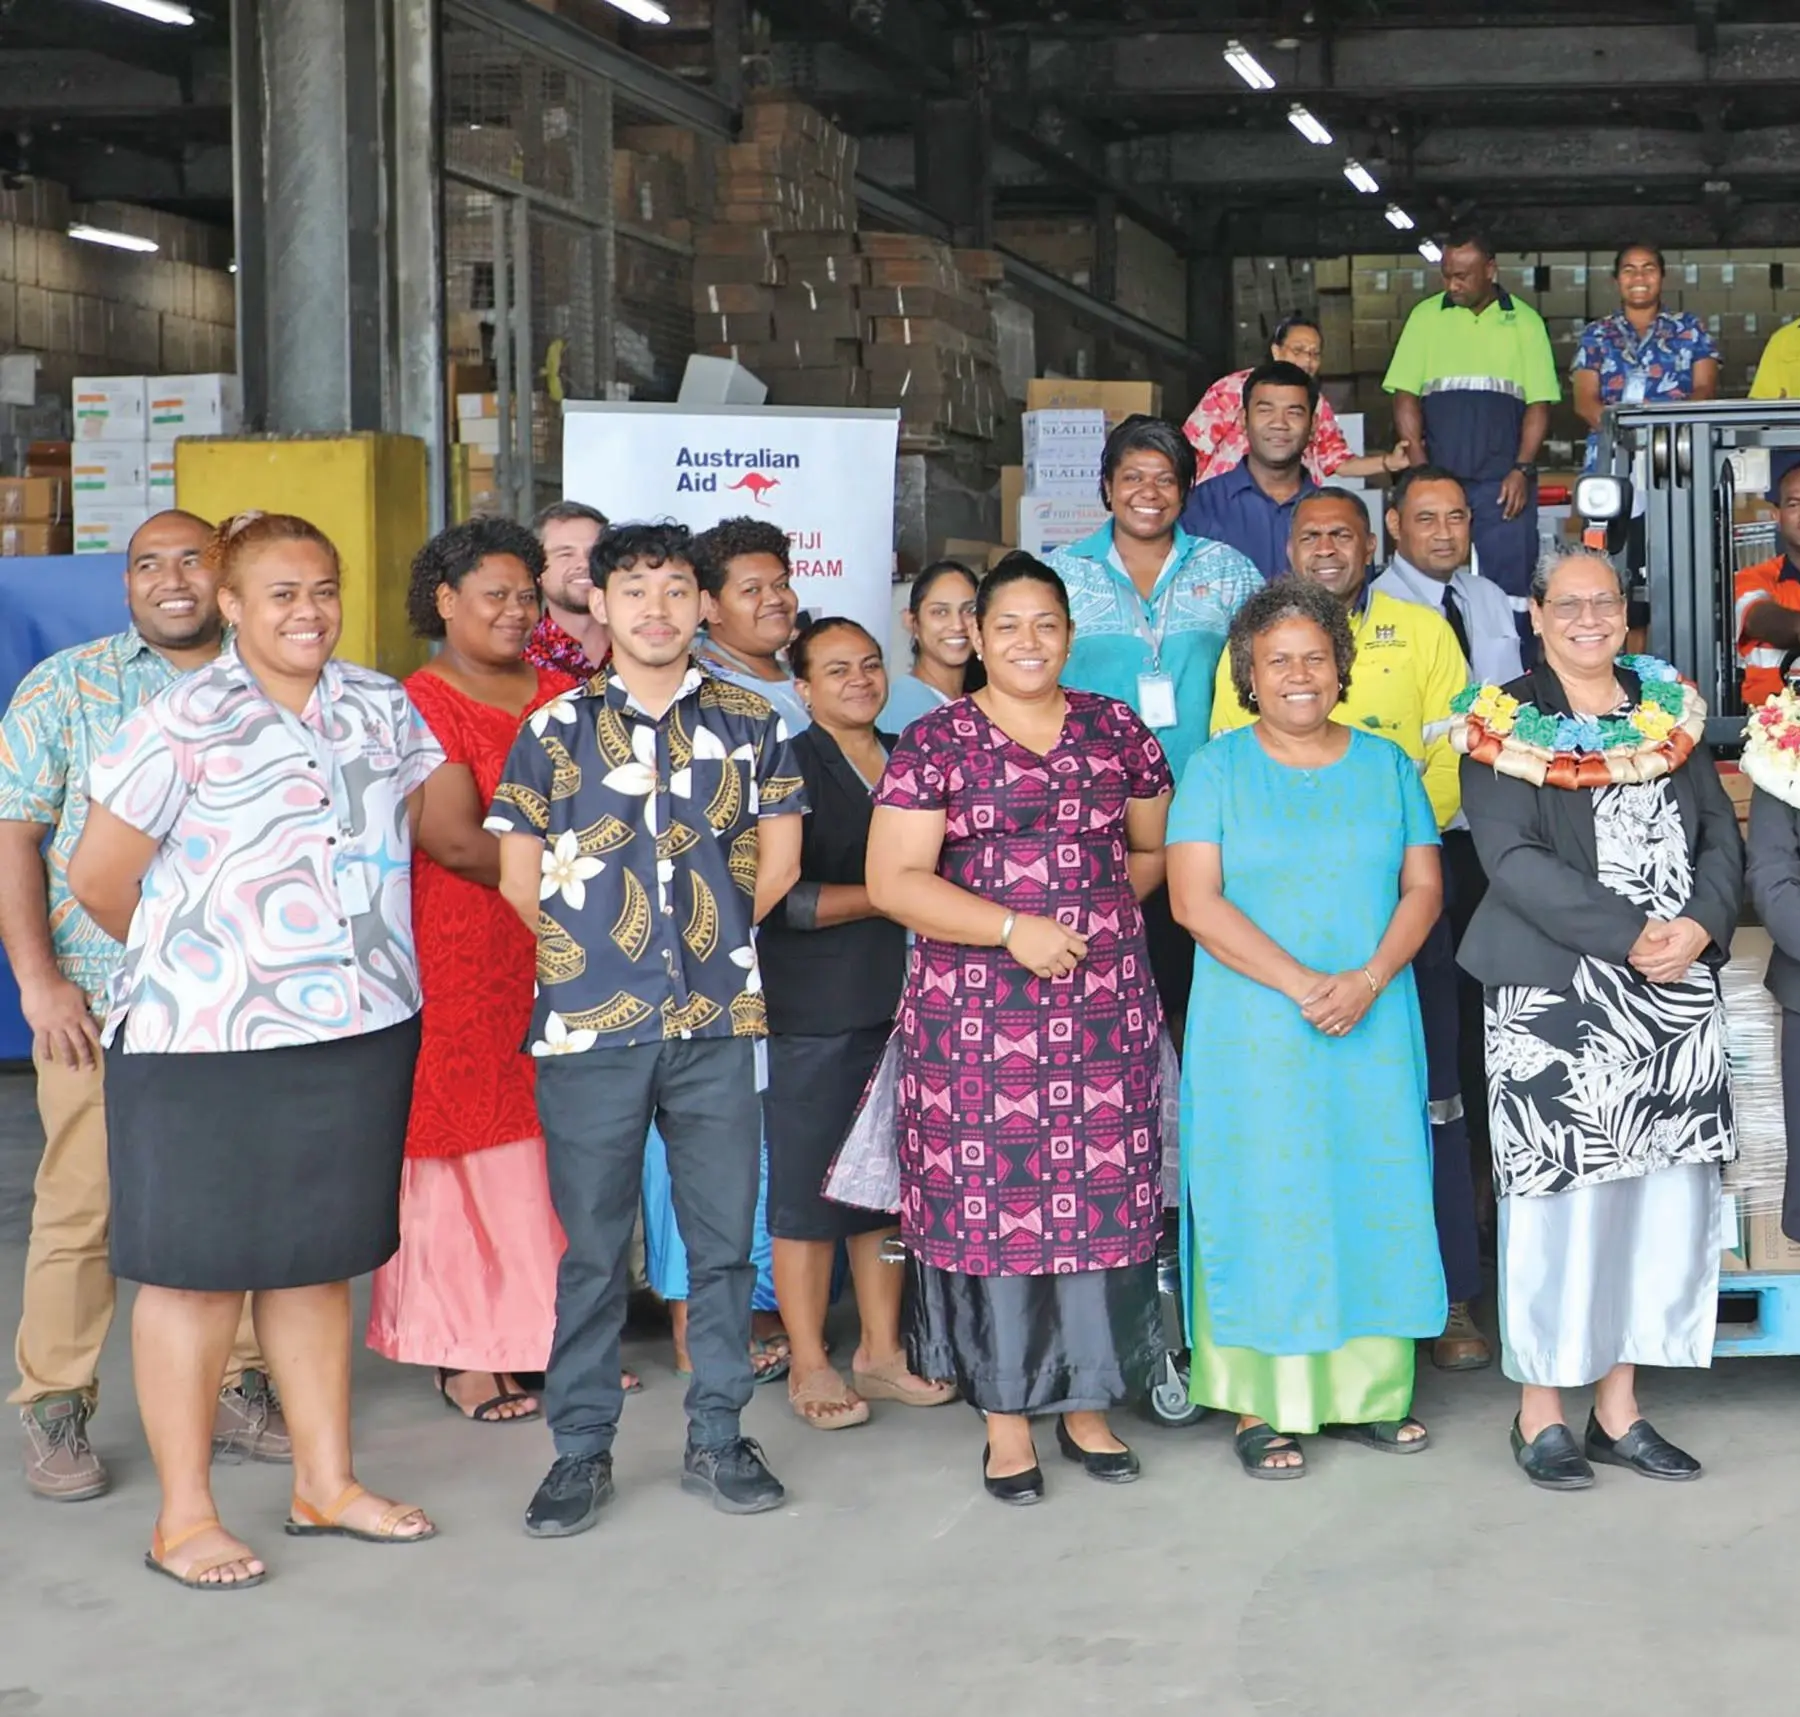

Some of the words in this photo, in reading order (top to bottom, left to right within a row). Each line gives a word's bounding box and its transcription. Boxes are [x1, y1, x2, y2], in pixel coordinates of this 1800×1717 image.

[1042, 425, 1103, 436] SEALED
[676, 447, 800, 468] Australian
[676, 472, 717, 492] Aid
[786, 531, 821, 549] FIJI
